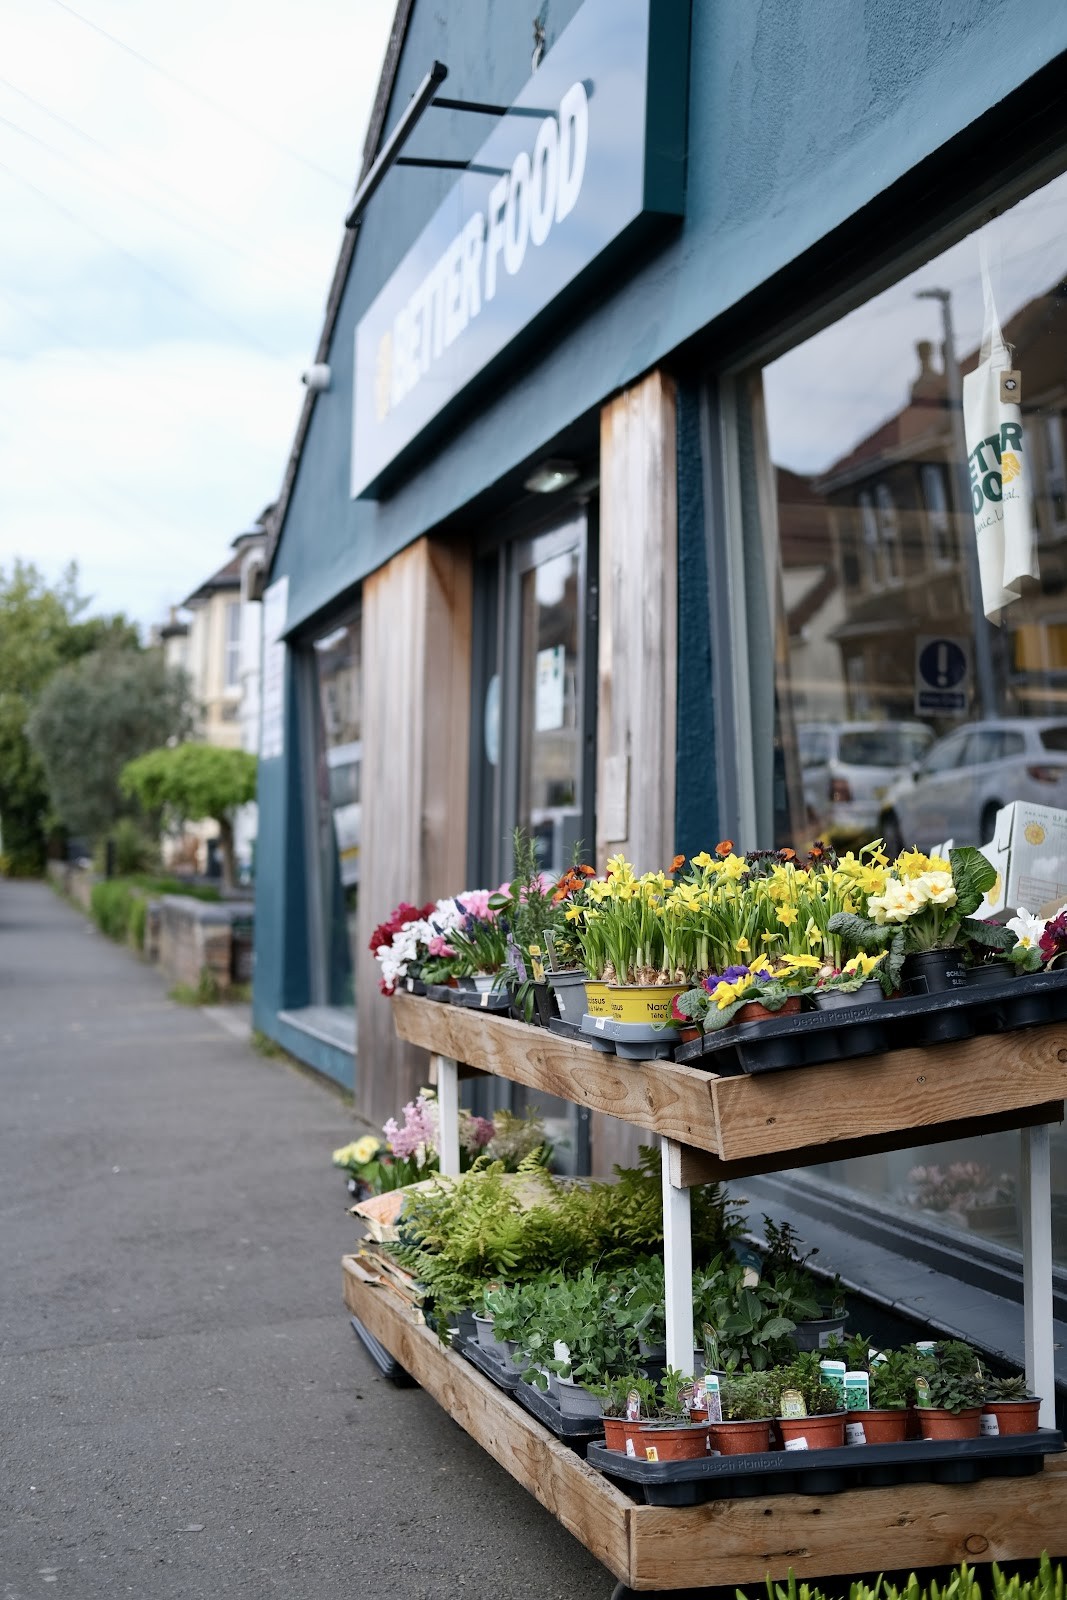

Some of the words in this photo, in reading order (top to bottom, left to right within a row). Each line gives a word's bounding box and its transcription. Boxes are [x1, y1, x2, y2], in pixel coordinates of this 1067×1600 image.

[391, 212, 484, 408] BETTER
[485, 82, 589, 302] FOOD
[647, 1003, 668, 1011] Narc
